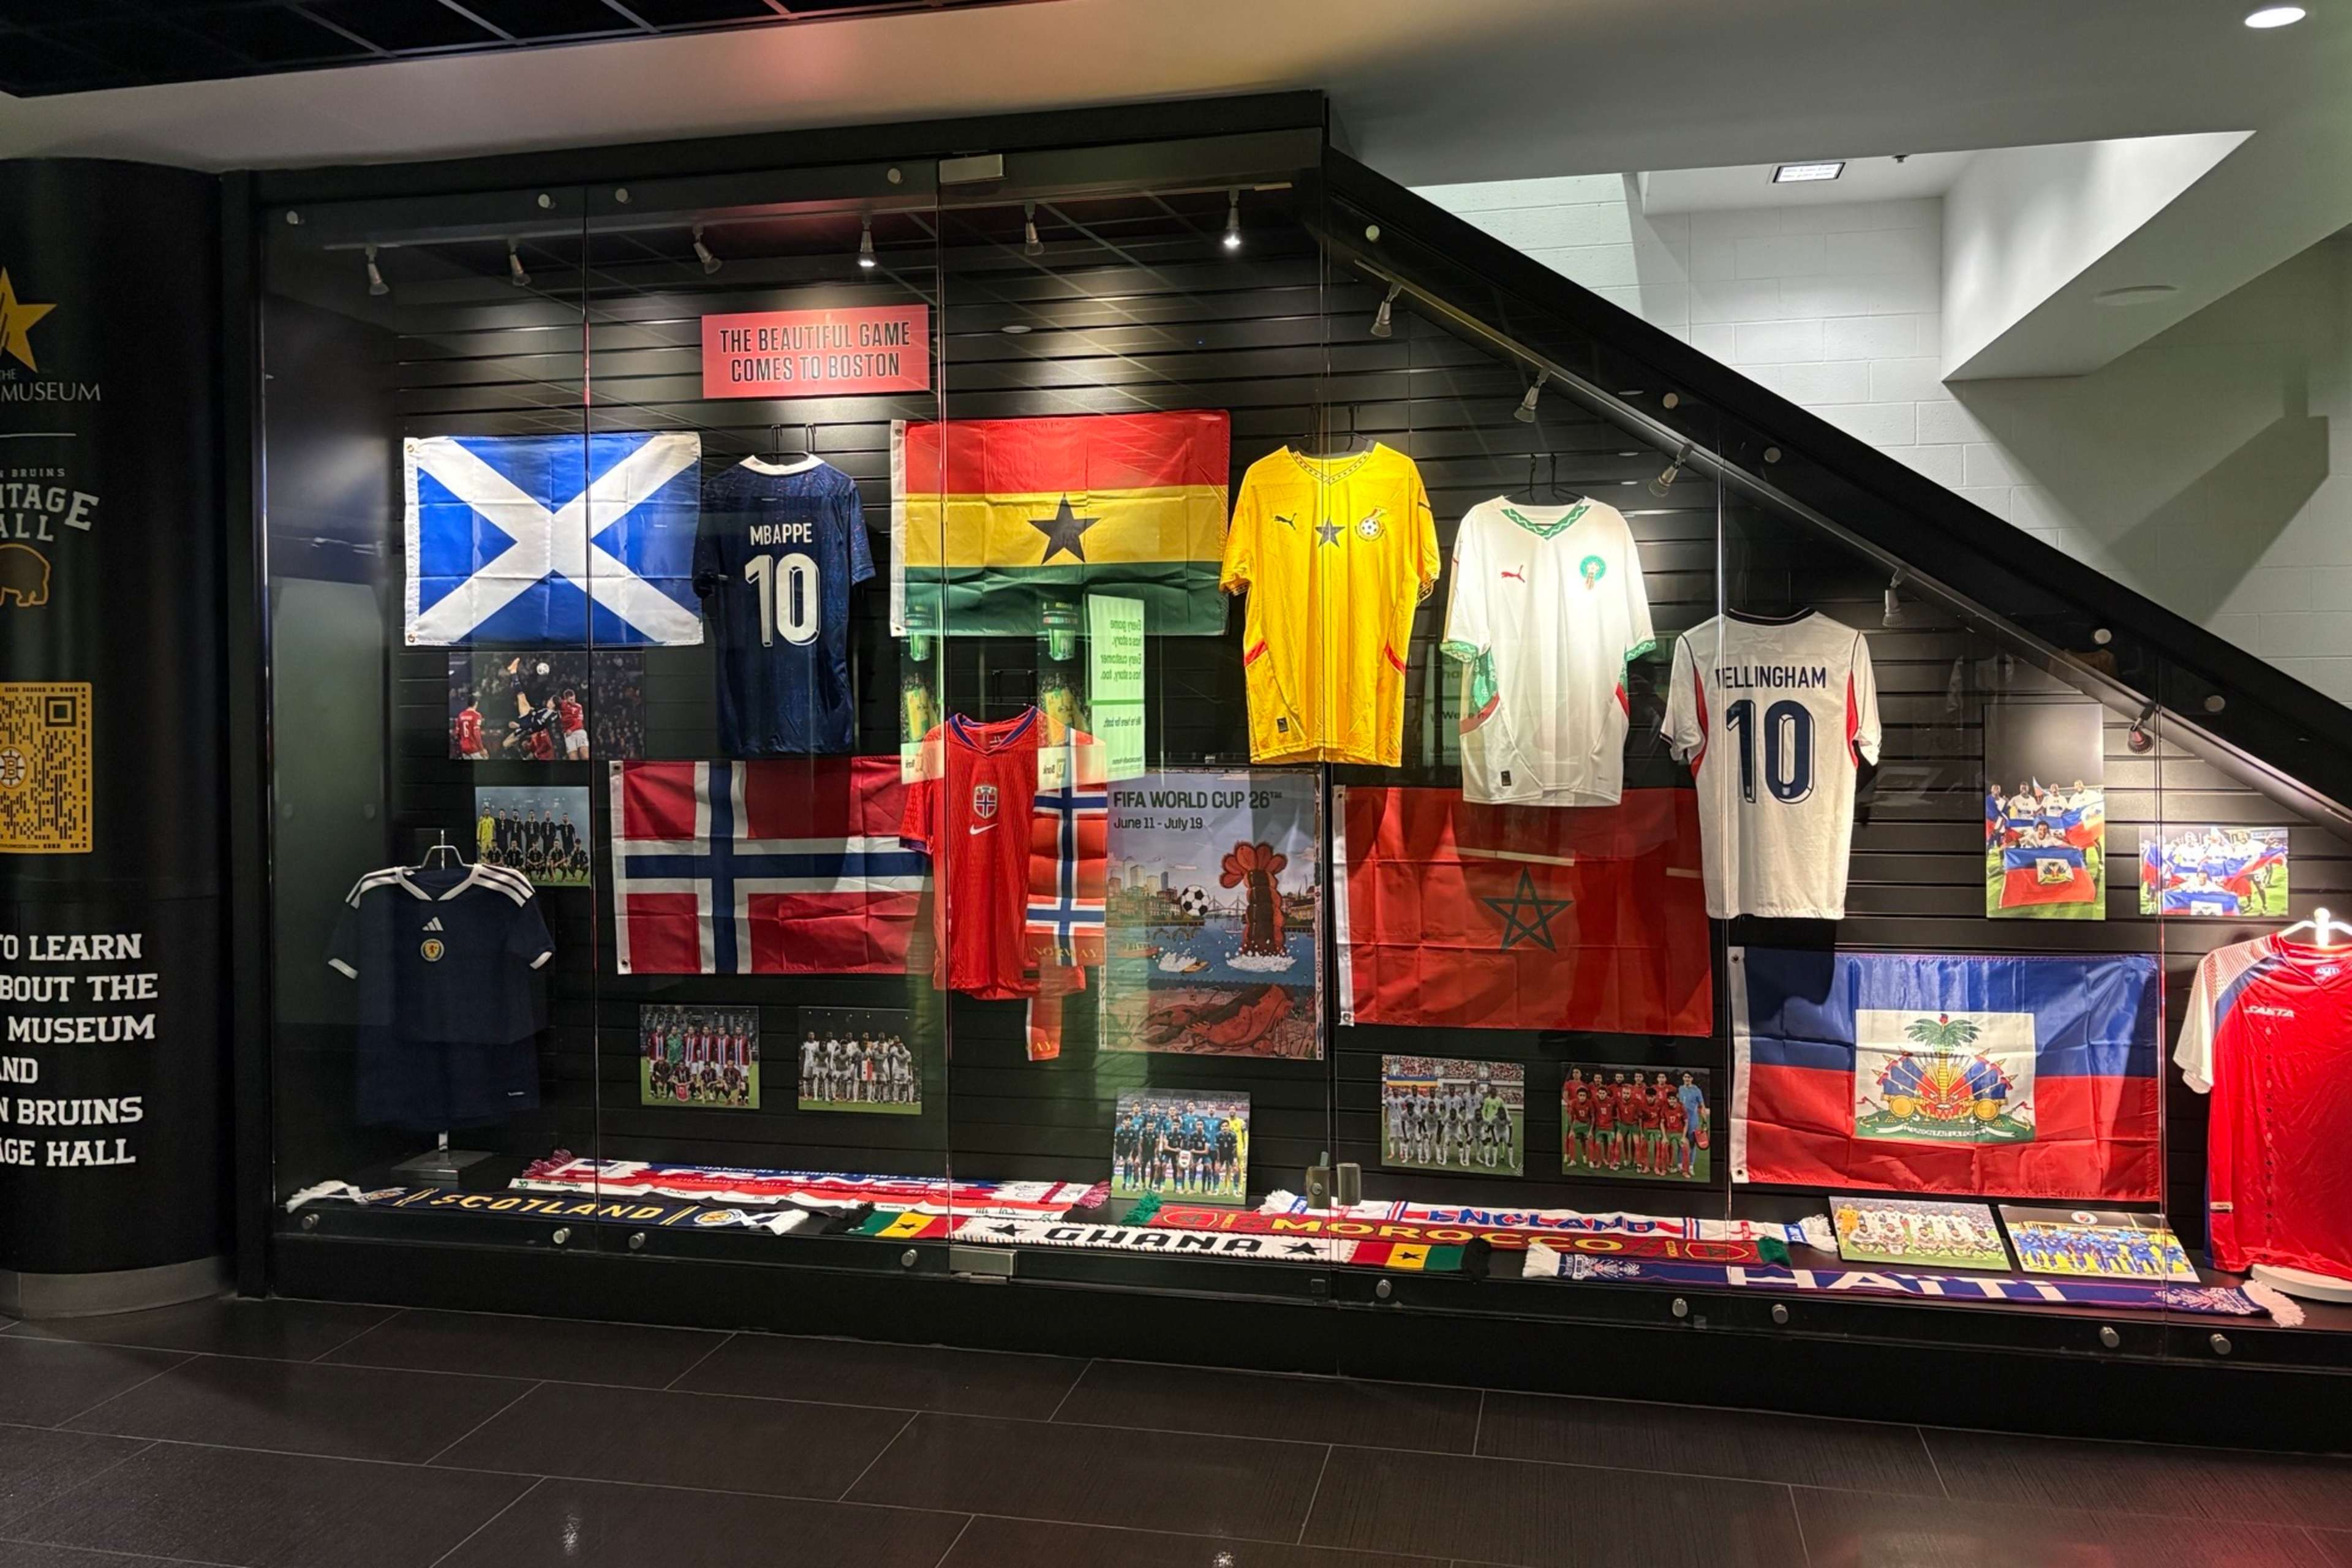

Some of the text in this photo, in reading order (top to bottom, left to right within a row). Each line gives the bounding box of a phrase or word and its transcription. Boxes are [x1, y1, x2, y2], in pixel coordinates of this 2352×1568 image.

[720, 321, 910, 353] THE BEAUTIFUL GAME
[731, 352, 900, 382] COMES TO BOSTON
[2, 382, 101, 401] MUSEUM
[12, 468, 66, 477] BRUINS
[749, 522, 813, 546] MBAPPE
[745, 552, 820, 647] 10
[1725, 699, 1815, 805] 10
[1114, 791, 1147, 808] FIFA
[1149, 791, 1208, 809] WORLD
[1212, 791, 1245, 809] CUP
[1114, 817, 1141, 829] June
[1144, 818, 1156, 829] 11
[1164, 817, 1189, 831] July
[1190, 817, 1204, 830] 19
[0, 933, 142, 961] O LEARN
[86, 973, 158, 1001] THE
[8, 1014, 156, 1043] MUSEUM
[0, 1056, 38, 1084] ND
[17, 1096, 143, 1126] BRUINS
[47, 1138, 137, 1166] HALL
[431, 1194, 665, 1219] SCOTLAND
[1270, 1218, 1624, 1251] MOROCCO
[1428, 1208, 1657, 1234] ENGLAND
[1044, 1227, 1264, 1253] GHANA
